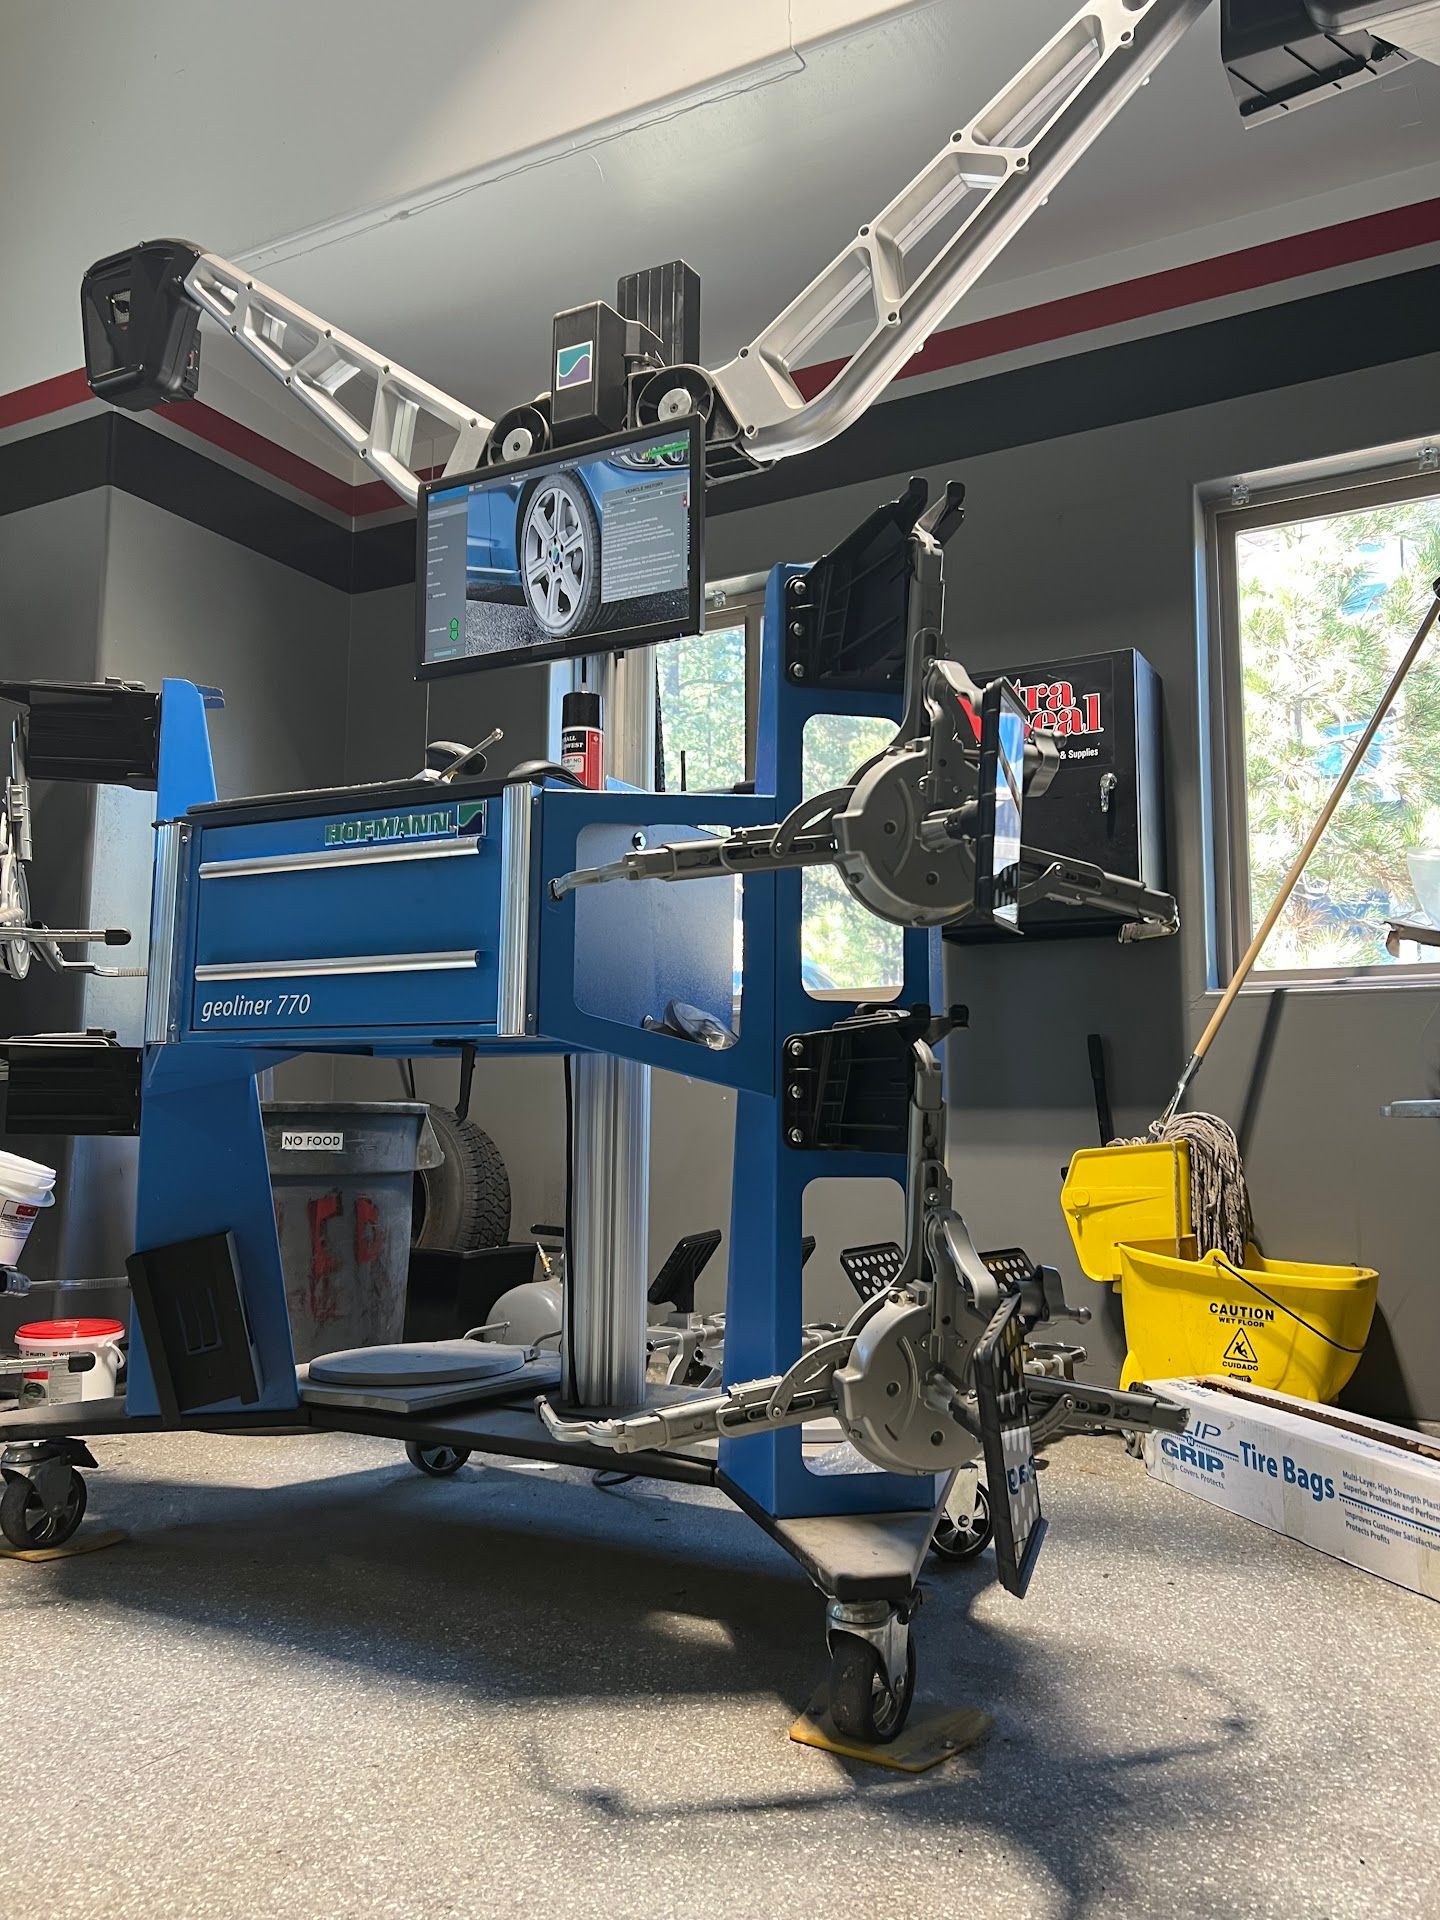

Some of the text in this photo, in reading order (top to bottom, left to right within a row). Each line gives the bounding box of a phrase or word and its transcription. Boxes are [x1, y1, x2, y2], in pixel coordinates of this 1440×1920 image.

[1025, 693, 1104, 738] eal
[1059, 747, 1099, 760] & Supplies
[325, 812, 451, 846] HOFMANN
[201, 993, 311, 1022] geoliner 770
[284, 1136, 340, 1146] NO FOOD
[1209, 1302, 1275, 1322] CAUTION
[1218, 1316, 1265, 1328] WET FLOOR
[1222, 1361, 1259, 1371] CUIDADO
[1185, 1420, 1222, 1439] IP
[1161, 1437, 1224, 1473] GRIP
[1239, 1440, 1335, 1502] Tire Bags
[1343, 1482, 1368, 1497] Superior
[1369, 1491, 1401, 1509] Protection
[1402, 1505, 1415, 1514] and
[1377, 1483, 1393, 1495] High
[1394, 1488, 1422, 1506] Strength
[1344, 1508, 1372, 1527] Improves
[1372, 1520, 1402, 1538] Customer
[1345, 1520, 1390, 1545] Protects Profits
